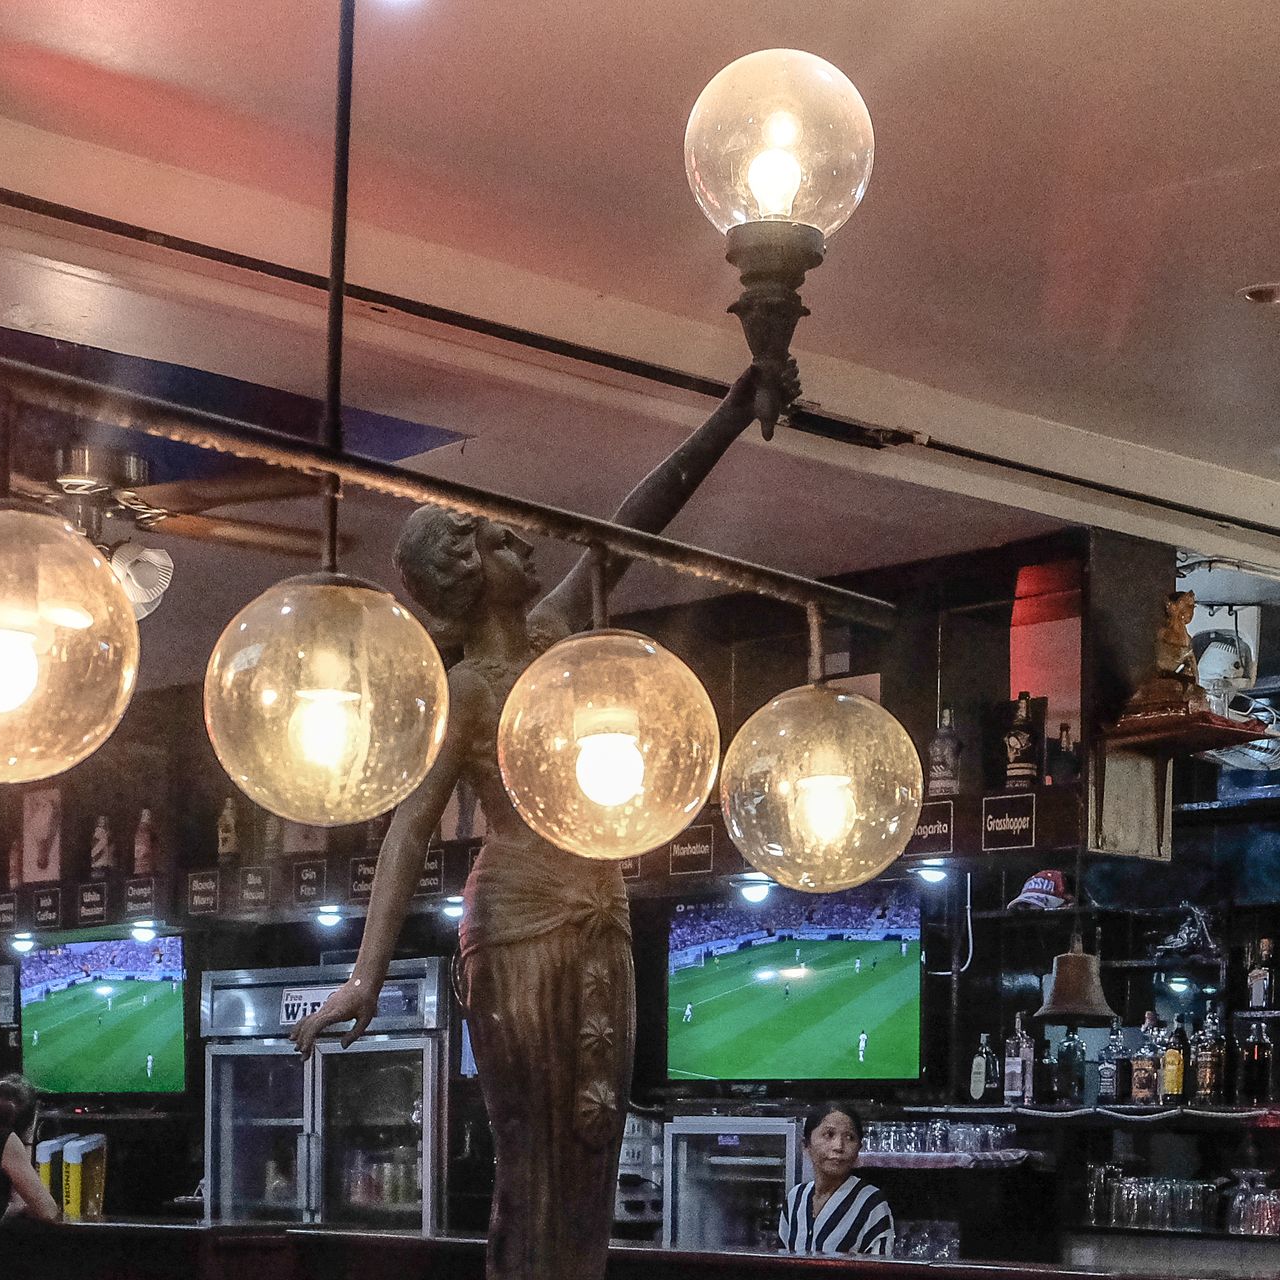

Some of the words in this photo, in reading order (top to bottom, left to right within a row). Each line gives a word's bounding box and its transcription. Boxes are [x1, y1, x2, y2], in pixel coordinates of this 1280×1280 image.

[986, 812, 1030, 836] Grasshopper
[672, 843, 710, 857] Manhattan
[285, 1001, 326, 1021] WiF
